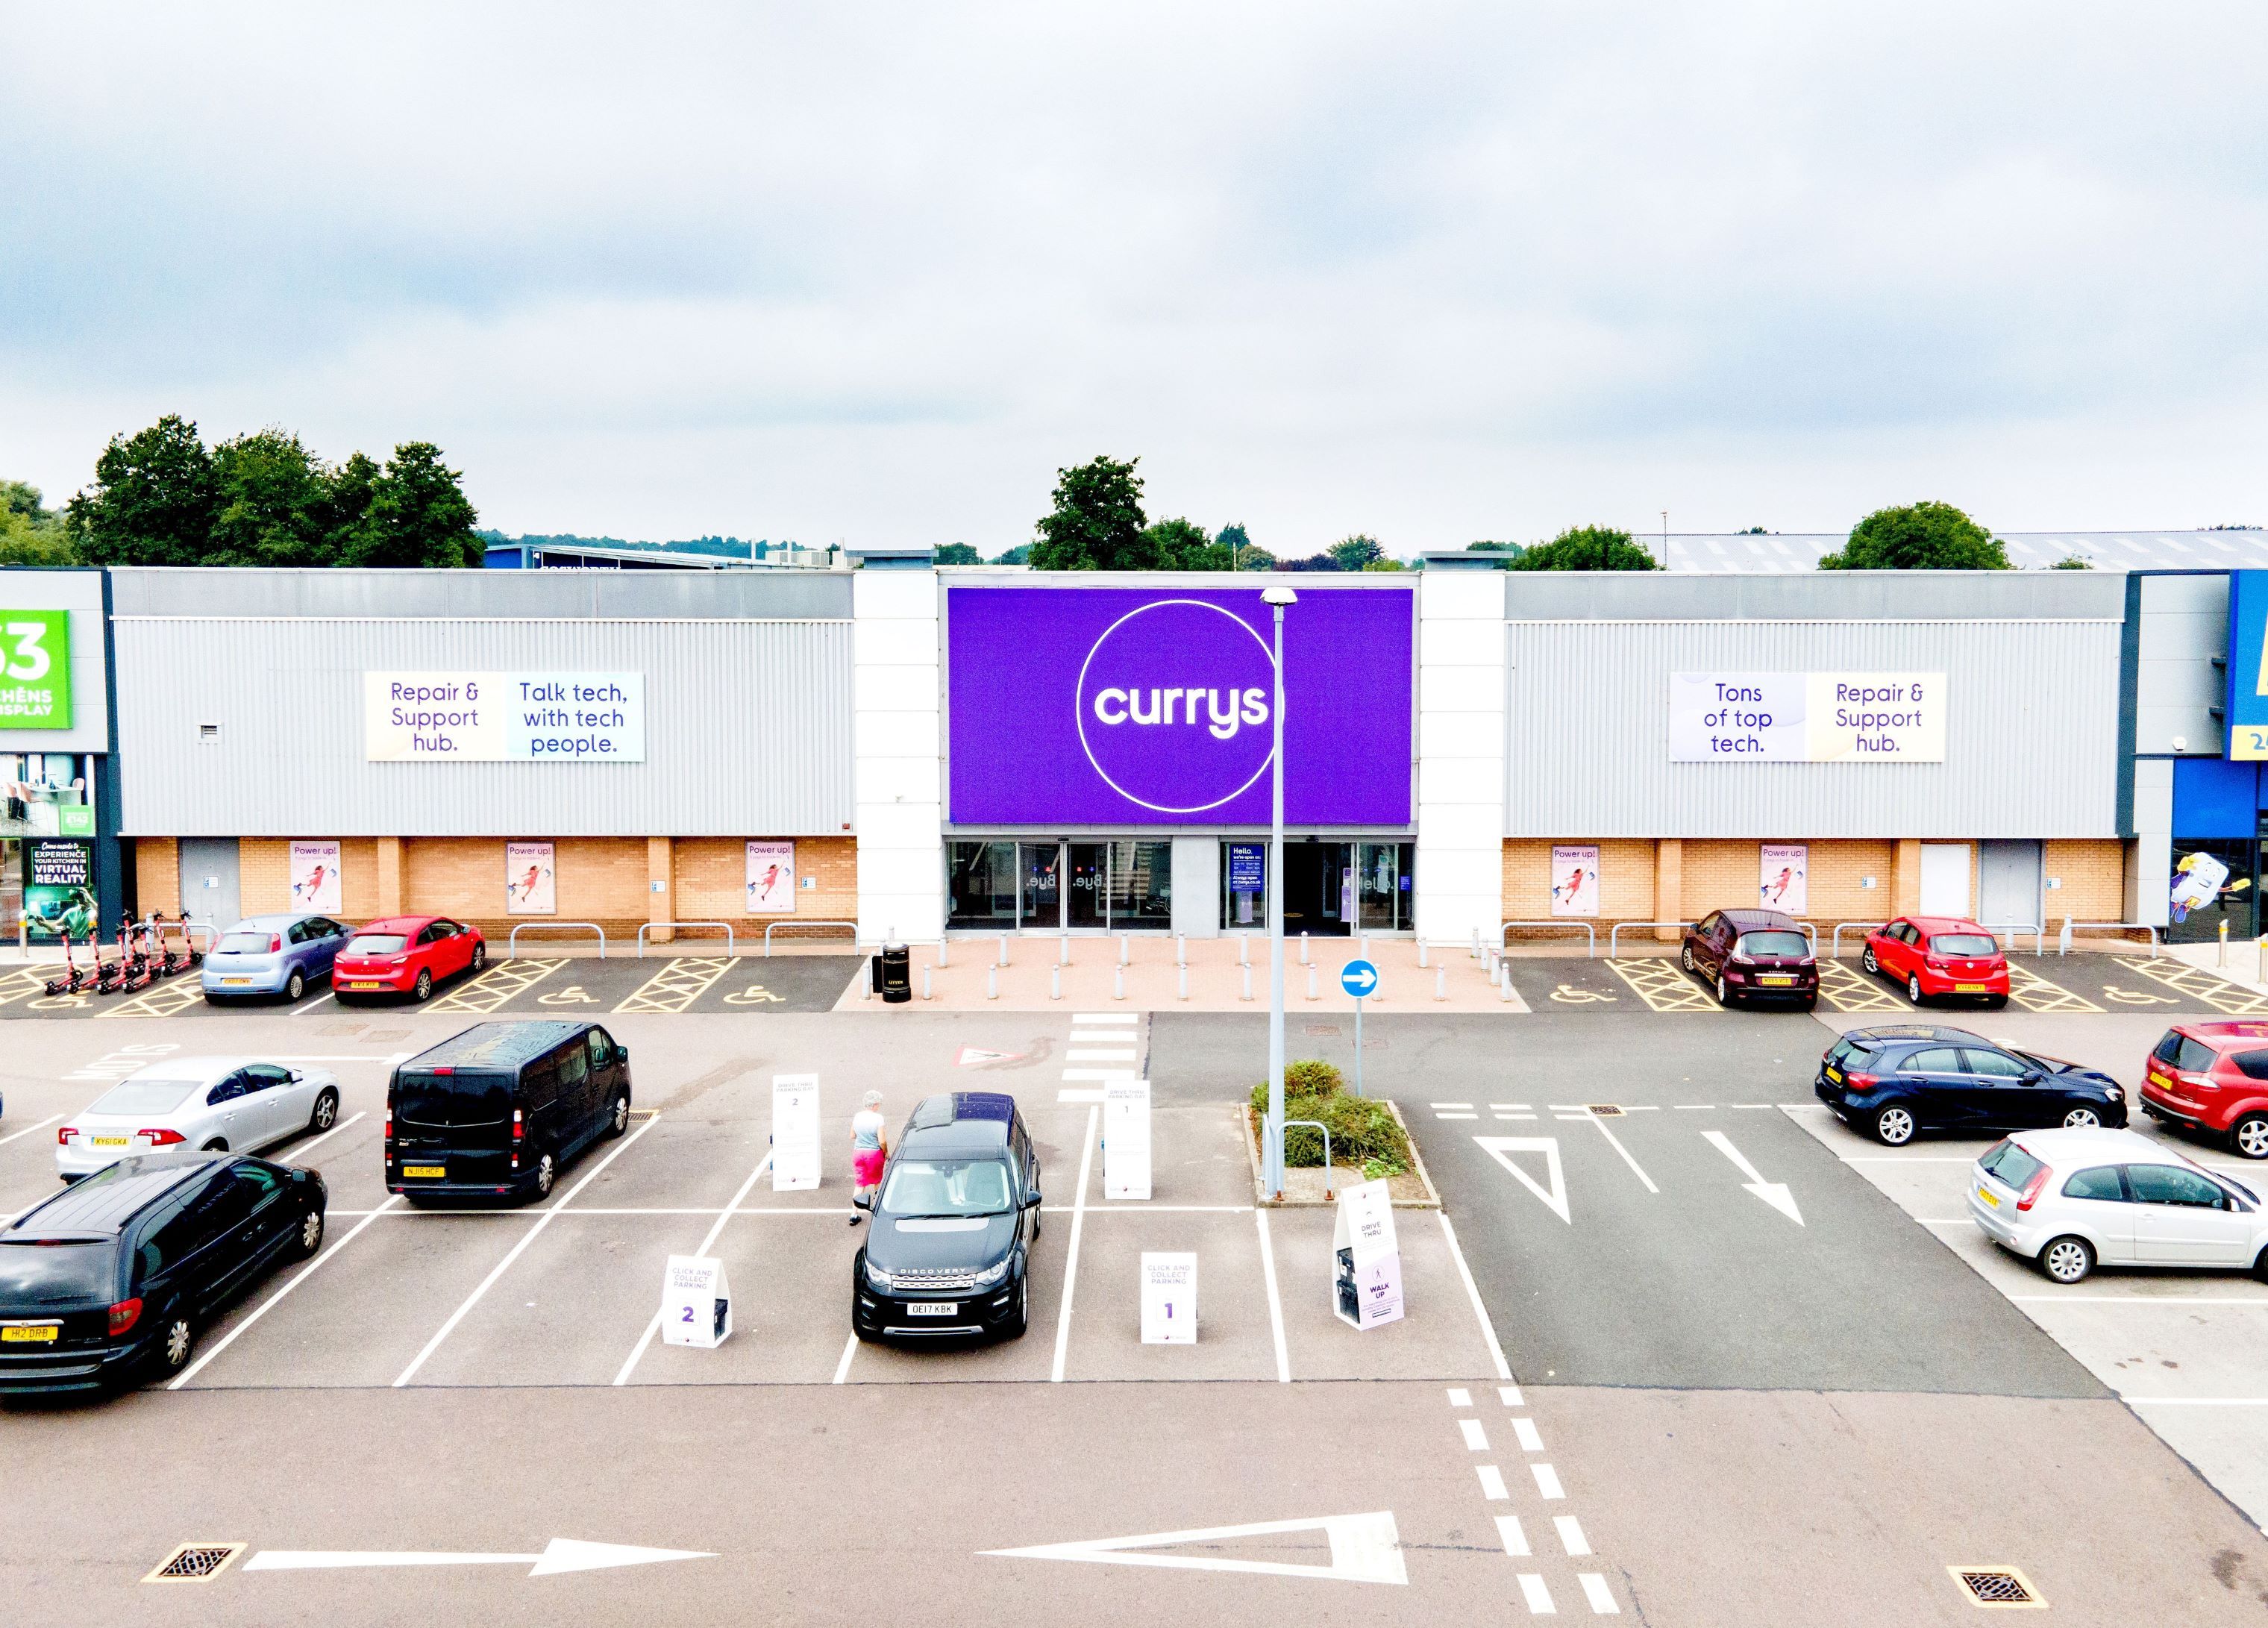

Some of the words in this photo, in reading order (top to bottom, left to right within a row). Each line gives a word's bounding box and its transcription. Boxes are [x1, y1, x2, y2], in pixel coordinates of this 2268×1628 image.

[0, 622, 51, 680] 3
[392, 682, 459, 705] Repair
[466, 682, 479, 701] &
[519, 682, 566, 701] Talk
[572, 683, 627, 704] tech,
[1715, 683, 1762, 702] Tons
[1837, 683, 1903, 707] Repair
[1911, 683, 1923, 702] &
[392, 707, 478, 730] Support
[524, 708, 568, 727] with
[575, 708, 624, 727] tech
[1094, 688, 1268, 739] currys
[1704, 708, 1728, 727] of
[1735, 710, 1773, 731] top
[1835, 708, 1923, 731] Support
[413, 733, 458, 751] hub.
[531, 734, 618, 757] people.
[1711, 733, 1764, 752] tech.
[1856, 733, 1900, 752] hub.
[323, 847, 336, 856] up!
[510, 847, 535, 855] Power
[537, 848, 551, 857] up!
[749, 845, 775, 854] Power
[777, 846, 790, 855] up!
[1554, 850, 1580, 858] Power
[1582, 850, 1595, 859] up!
[1763, 848, 1788, 857] Power
[1791, 849, 1804, 858] up!
[34, 865, 86, 874] VIRTUAL
[35, 874, 87, 883] REALITY
[1361, 1221, 1382, 1232] DRIVE
[1363, 1230, 1382, 1239] THRU
[674, 1274, 708, 1283] COLLECT
[674, 1281, 707, 1290] PARKING
[1370, 1282, 1390, 1293] WALK
[1375, 1291, 1385, 1299] UP
[682, 1306, 695, 1323] 2
[912, 1305, 933, 1313] OE17
[935, 1305, 952, 1313] KBK
[1165, 1303, 1173, 1318] 1
[29, 1328, 48, 1337] DRB
